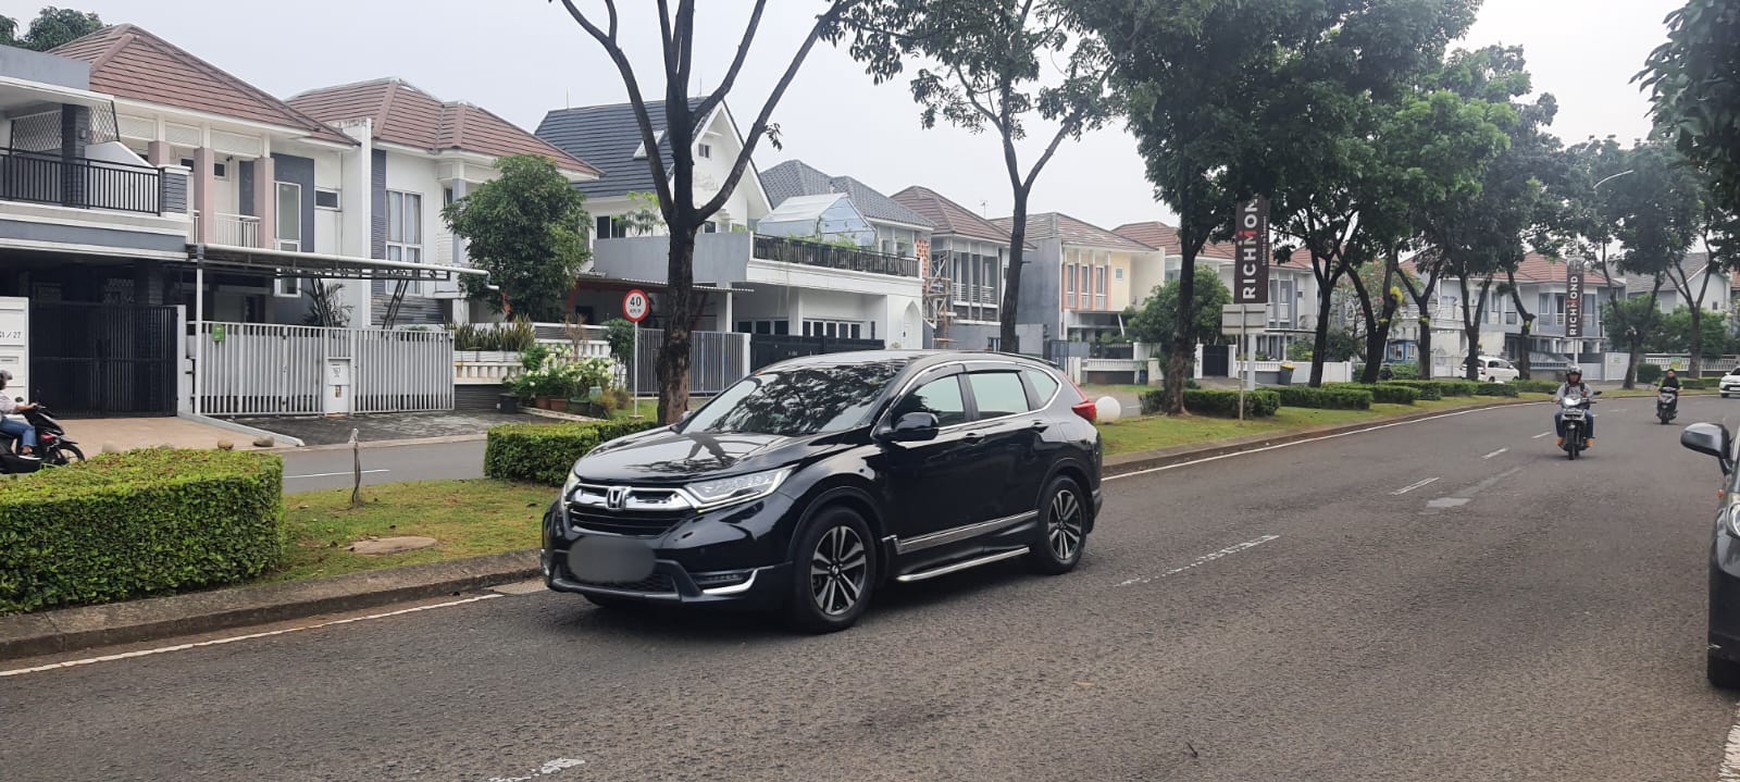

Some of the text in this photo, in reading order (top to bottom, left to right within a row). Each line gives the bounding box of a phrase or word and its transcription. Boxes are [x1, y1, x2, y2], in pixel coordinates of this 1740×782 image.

[1241, 198, 1258, 300] RICHMON
[630, 297, 642, 307] 40
[1569, 276, 1578, 336] RICHMOND
